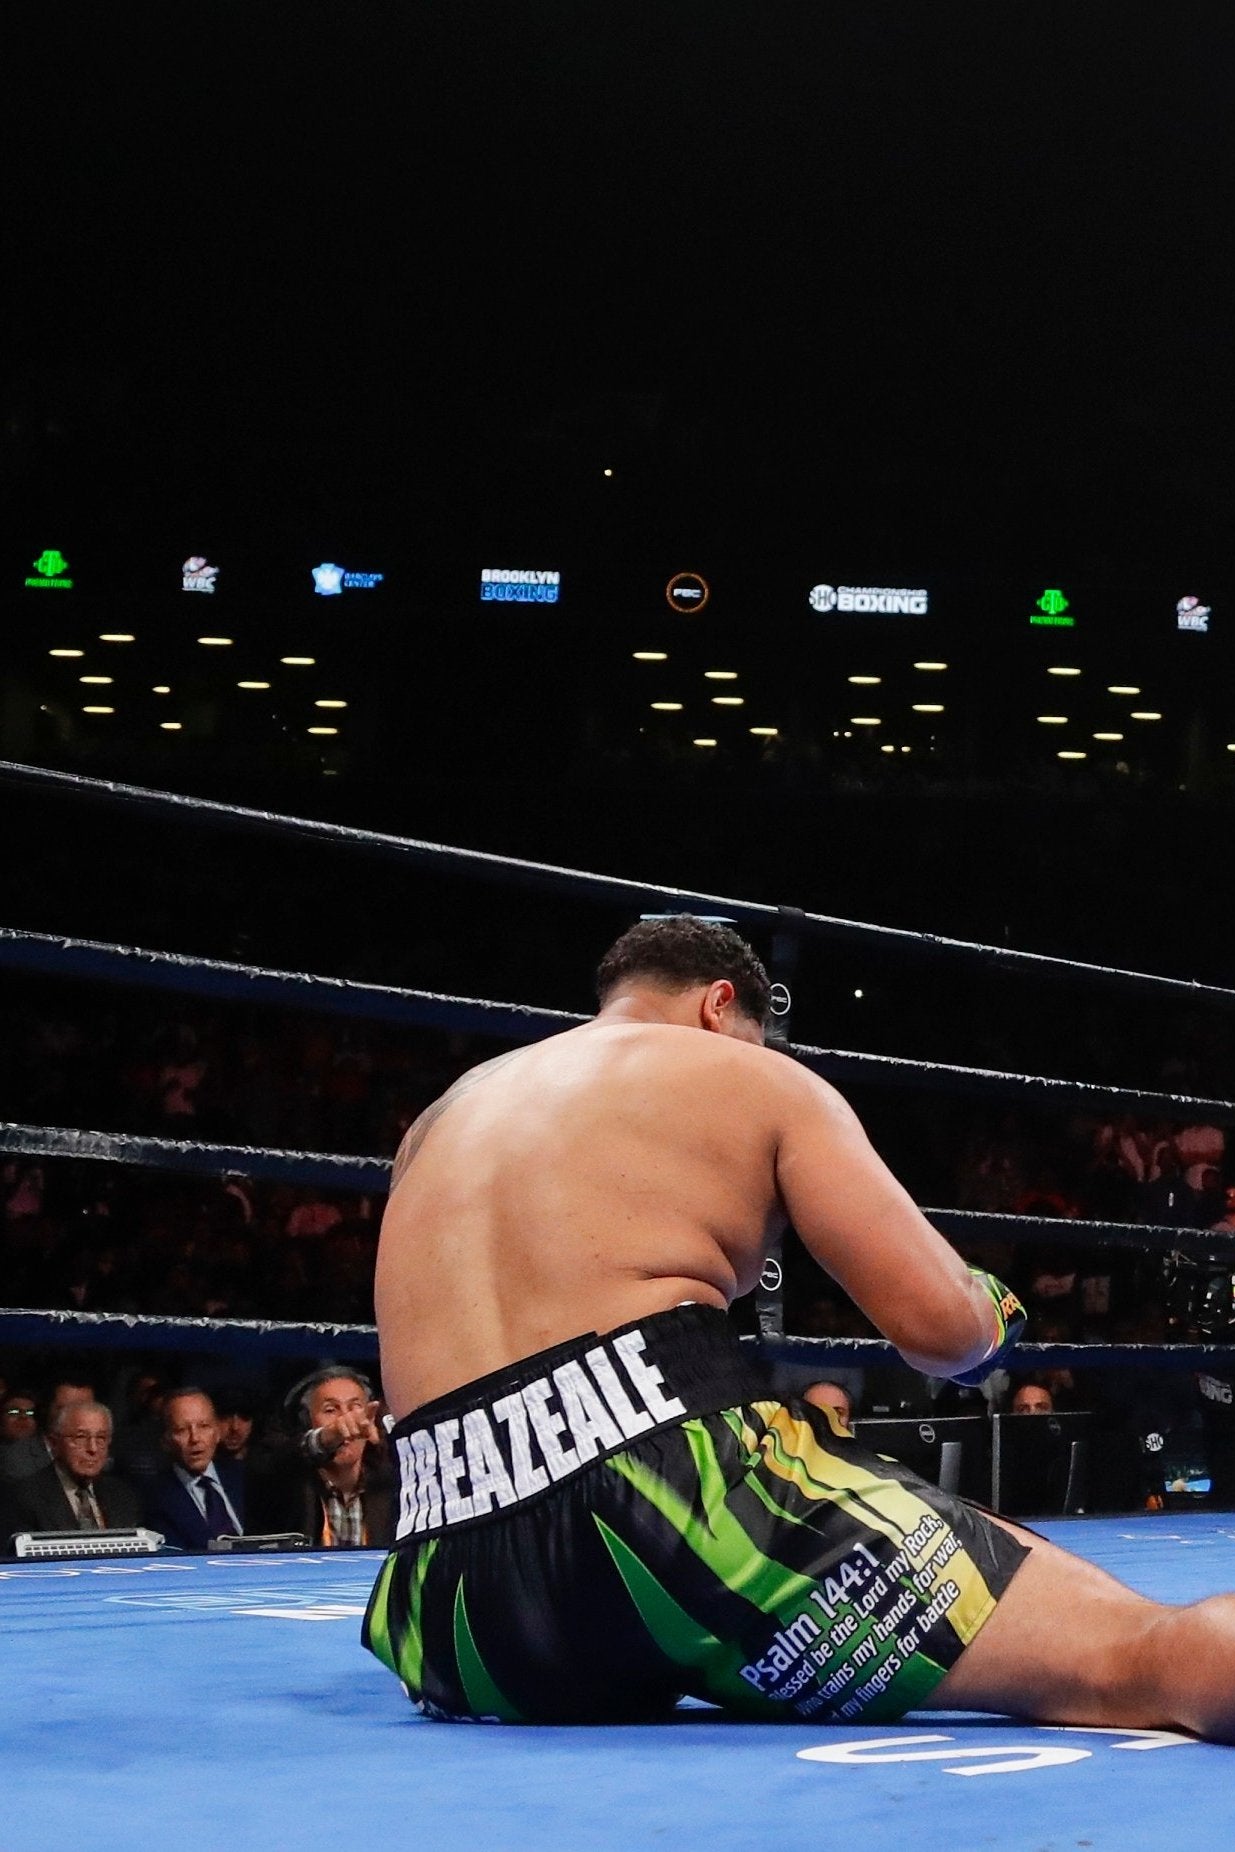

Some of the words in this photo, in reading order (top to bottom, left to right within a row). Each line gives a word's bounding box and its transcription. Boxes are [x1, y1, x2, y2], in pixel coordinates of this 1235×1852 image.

[480, 583, 559, 603] BOXING
[481, 569, 560, 585] BROOKLYN
[837, 594, 929, 615] BOXING
[1177, 616, 1209, 629] WBC
[395, 1328, 688, 1542] BREAZEALE
[738, 1612, 822, 1692] Psalm
[809, 1541, 881, 1620] 144:1
[810, 1641, 834, 1667] be
[829, 1614, 858, 1647] the
[853, 1576, 889, 1620] Lord
[884, 1552, 910, 1584] my
[903, 1514, 943, 1556] Rock,
[817, 1661, 856, 1703] trains
[851, 1634, 877, 1667] my
[874, 1587, 917, 1641] hands
[912, 1564, 937, 1594] for
[931, 1531, 963, 1568] war,
[839, 1694, 865, 1719] my
[854, 1652, 902, 1703] fingers
[896, 1629, 921, 1659] for
[915, 1579, 961, 1633] battle
